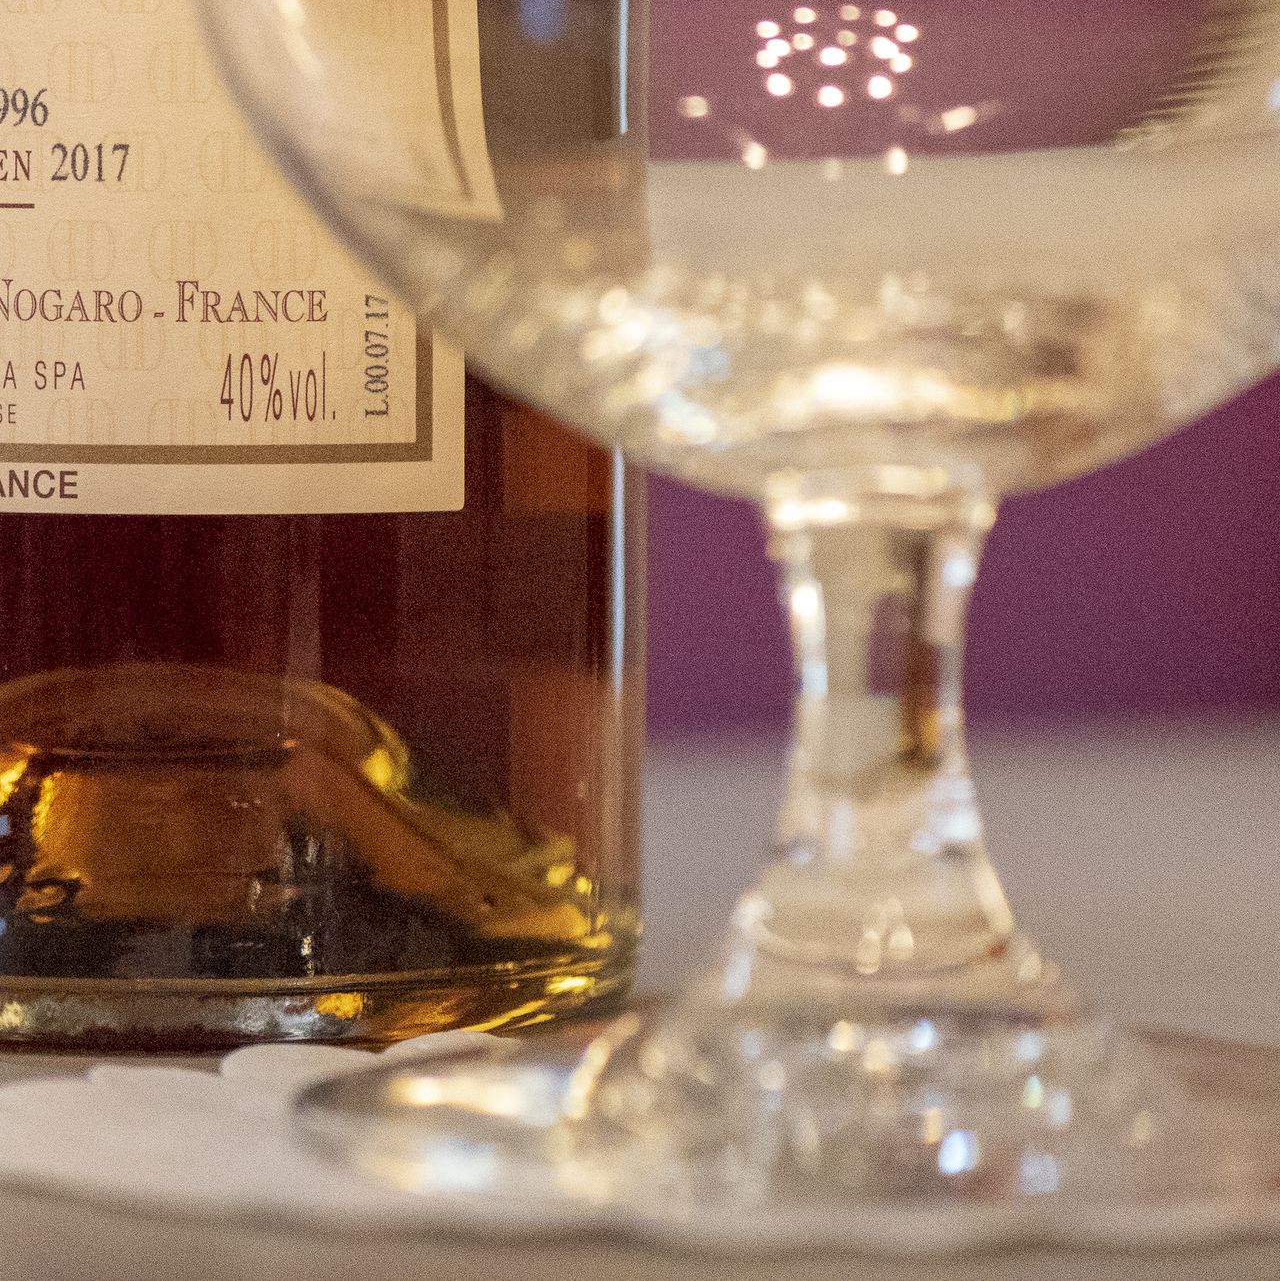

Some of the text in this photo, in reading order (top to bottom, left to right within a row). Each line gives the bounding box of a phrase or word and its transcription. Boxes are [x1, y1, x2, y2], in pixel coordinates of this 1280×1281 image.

[51, 142, 131, 183] 2017
[175, 280, 329, 324] FRANCE
[34, 361, 86, 391] SPA
[364, 293, 390, 419] L.00.07.17
